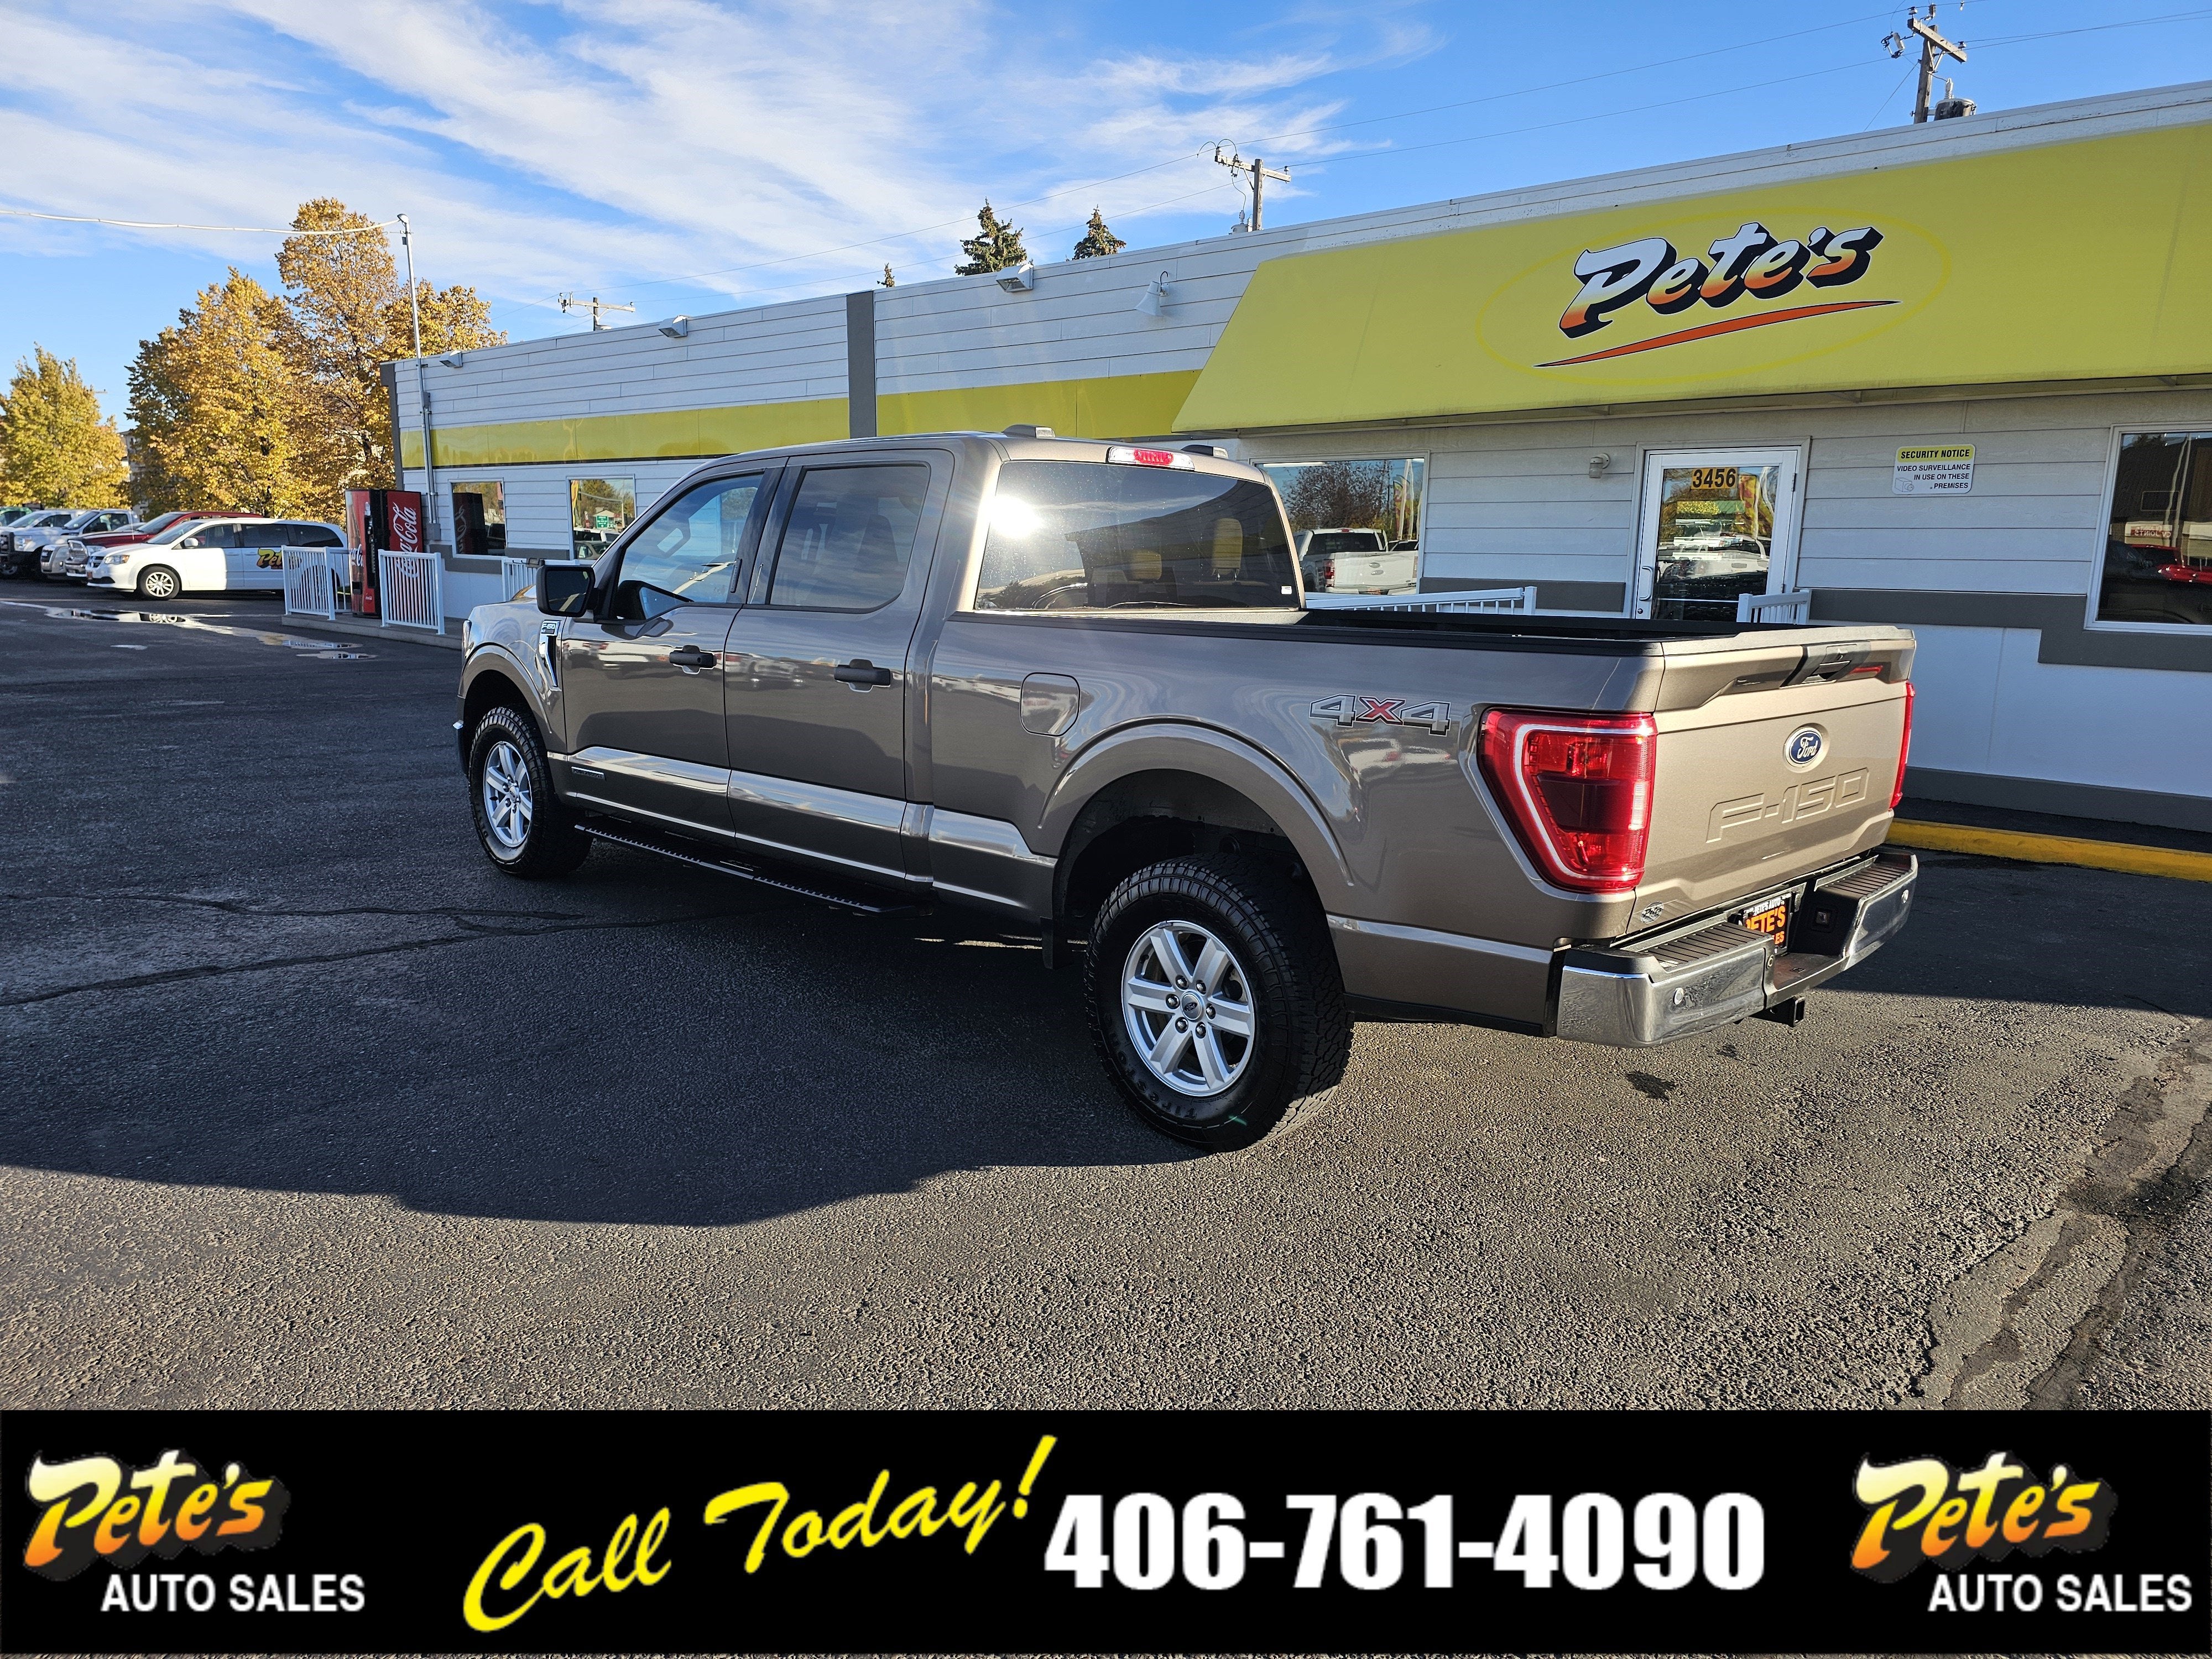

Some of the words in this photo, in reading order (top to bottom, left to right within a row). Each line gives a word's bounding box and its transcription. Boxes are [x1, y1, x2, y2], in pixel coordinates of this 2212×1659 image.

[1559, 222, 1884, 338] Pete's
[1901, 450, 1939, 458] SECURITY
[1941, 449, 1970, 458] NOTICE
[1692, 468, 1736, 488] 3456
[1797, 737, 1819, 759] Ford
[1706, 767, 1870, 843] F-150
